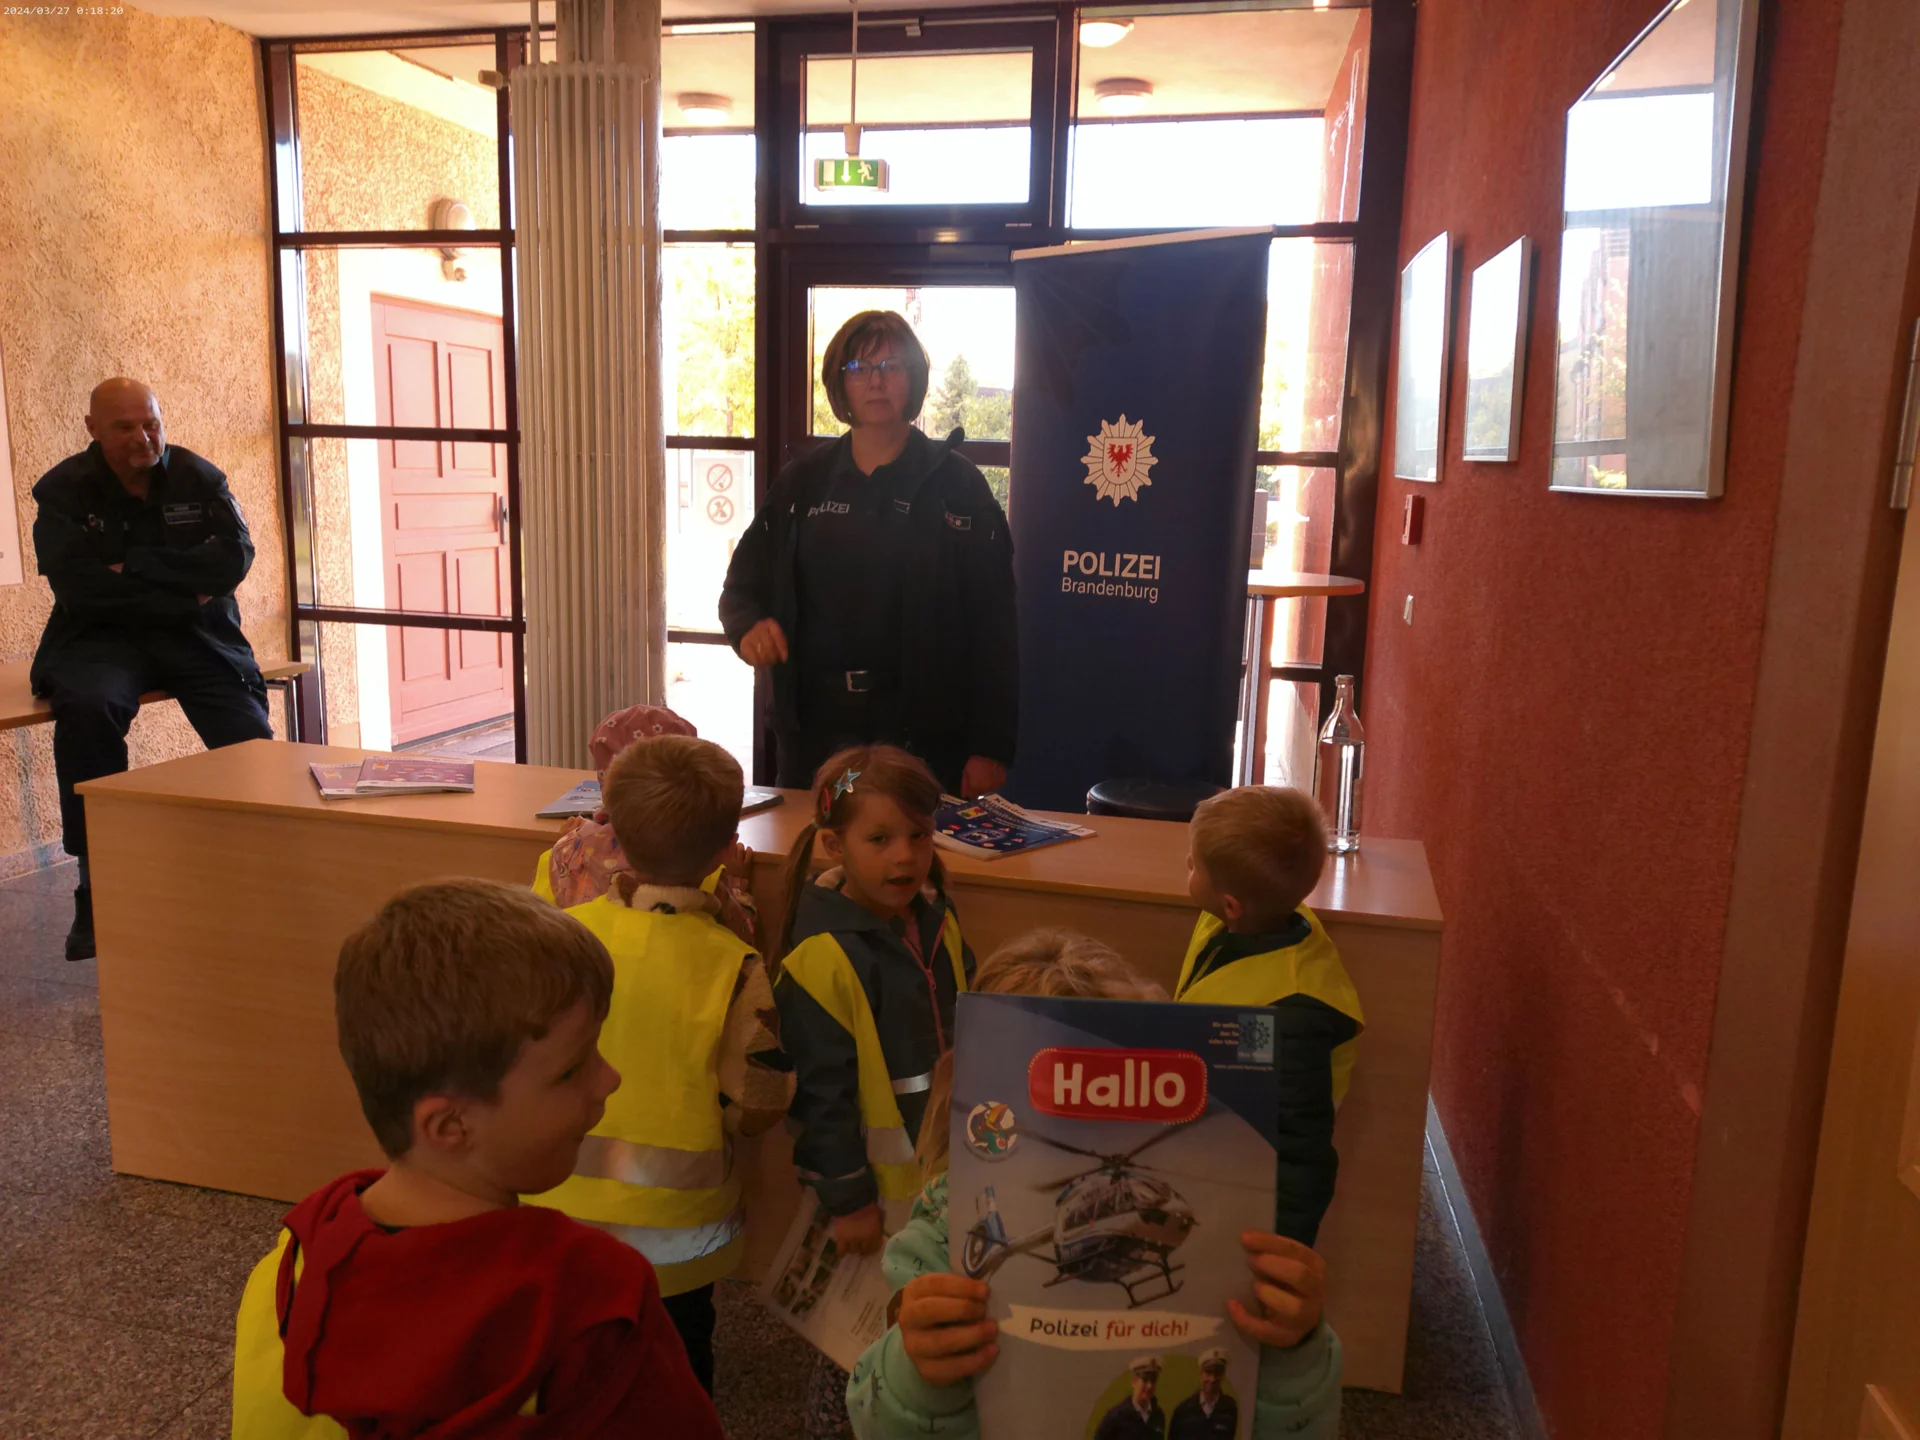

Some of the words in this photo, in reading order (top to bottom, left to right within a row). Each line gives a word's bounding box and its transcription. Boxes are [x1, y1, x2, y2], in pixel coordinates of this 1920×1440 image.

[1063, 550, 1161, 580] POLIZEI
[1061, 577, 1159, 604] Brandenburg
[1053, 1058, 1186, 1108] Hallo
[1030, 1317, 1098, 1338] Polizei
[1106, 1320, 1135, 1341] für
[1141, 1320, 1189, 1338] dich!
